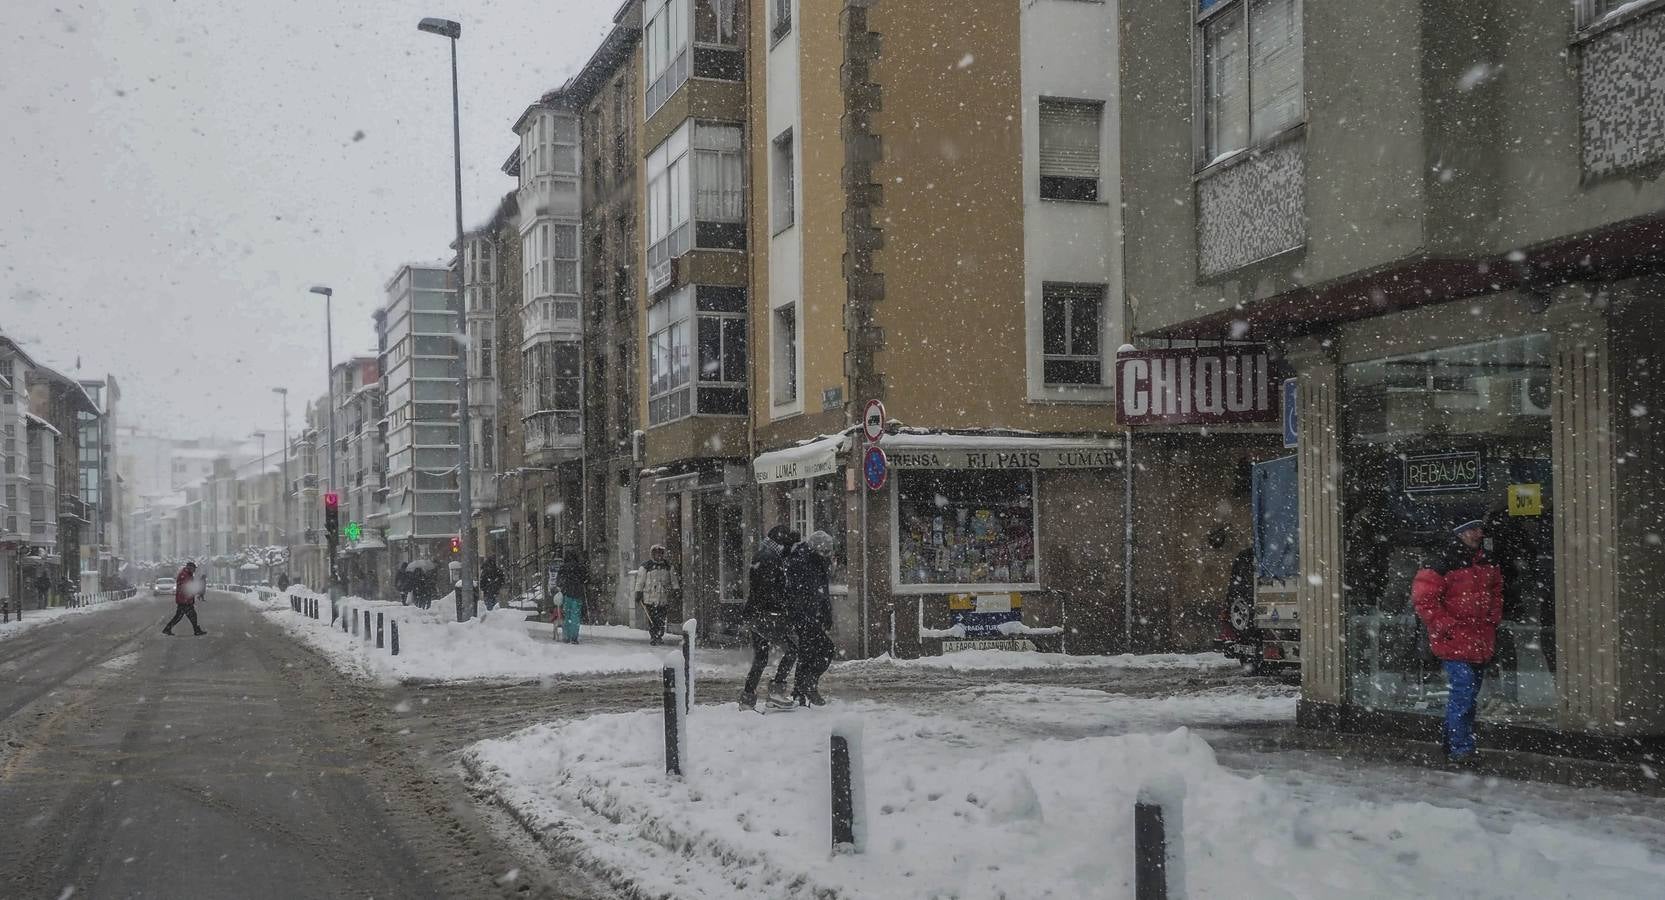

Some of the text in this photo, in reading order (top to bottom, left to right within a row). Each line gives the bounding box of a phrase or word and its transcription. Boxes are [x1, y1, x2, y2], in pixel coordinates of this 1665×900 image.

[1123, 353, 1269, 416] CHIQUI
[886, 454, 940, 466] PRENSA
[966, 453, 994, 468] EL
[1057, 452, 1117, 466] LUMAR
[775, 462, 798, 478] LUMAR
[1409, 460, 1476, 484] REBAJAS
[944, 642, 954, 652] LA
